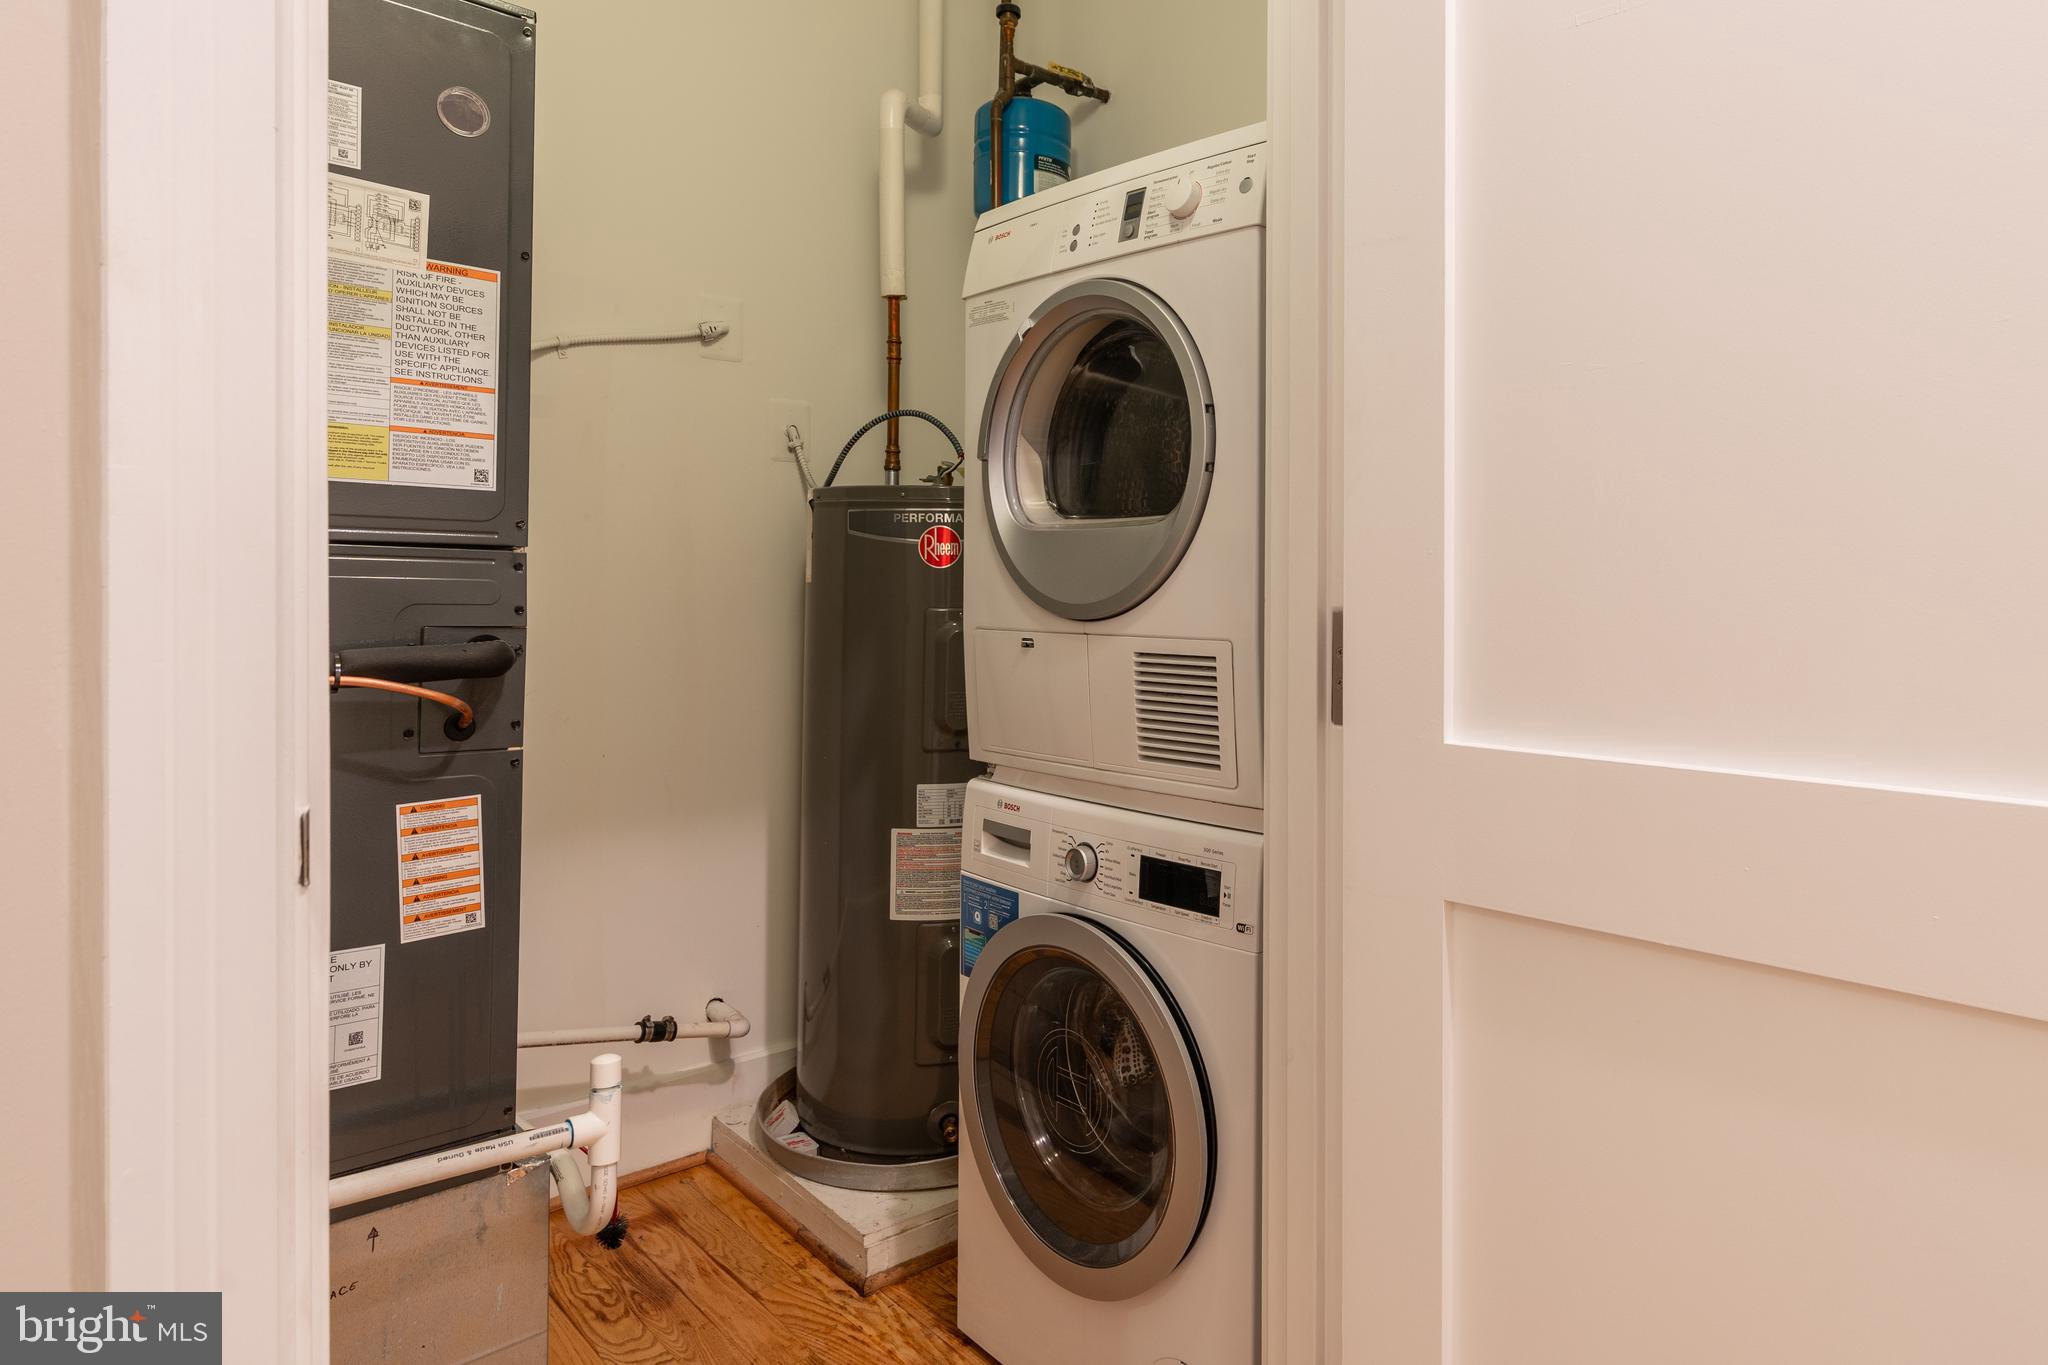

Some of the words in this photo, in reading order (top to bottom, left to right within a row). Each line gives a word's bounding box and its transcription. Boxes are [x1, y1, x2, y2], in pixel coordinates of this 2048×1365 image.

[995, 232, 1011, 241] BOSCH
[427, 262, 468, 276] WARNING
[421, 271, 433, 280] OF
[436, 276, 456, 284] FIRE
[396, 278, 444, 290] AUXILIARY
[447, 286, 485, 298] DEVICES
[396, 287, 427, 297] WHICH
[430, 292, 449, 301] MAY
[396, 296, 437, 308] IGNITION
[440, 302, 483, 314] SOURCES
[396, 305, 424, 315] SHALL
[428, 310, 446, 318] NOT
[396, 314, 446, 327] INSTALLED
[460, 323, 477, 331] THE
[395, 323, 452, 337] DUCTWORK,
[455, 331, 485, 341] OTHER
[395, 332, 420, 341] THAN
[423, 336, 469, 347] AUXILIARY
[395, 341, 435, 352] DEVICES
[438, 347, 469, 357] LISTED
[472, 351, 490, 359] FOR
[394, 359, 437, 370] SPECIFIC
[416, 353, 440, 361] WITH
[443, 356, 460, 364] THE
[394, 368, 413, 376] SEE
[416, 370, 484, 384] INSTRUCTIONS.
[894, 513, 963, 523] PERFORMA
[924, 527, 959, 562] Rheem
[1004, 802, 1020, 812] BOSCH
[330, 962, 357, 972] ONLY
[360, 960, 372, 968] BY
[475, 1144, 495, 1152] Made
[498, 1139, 513, 1148] USA
